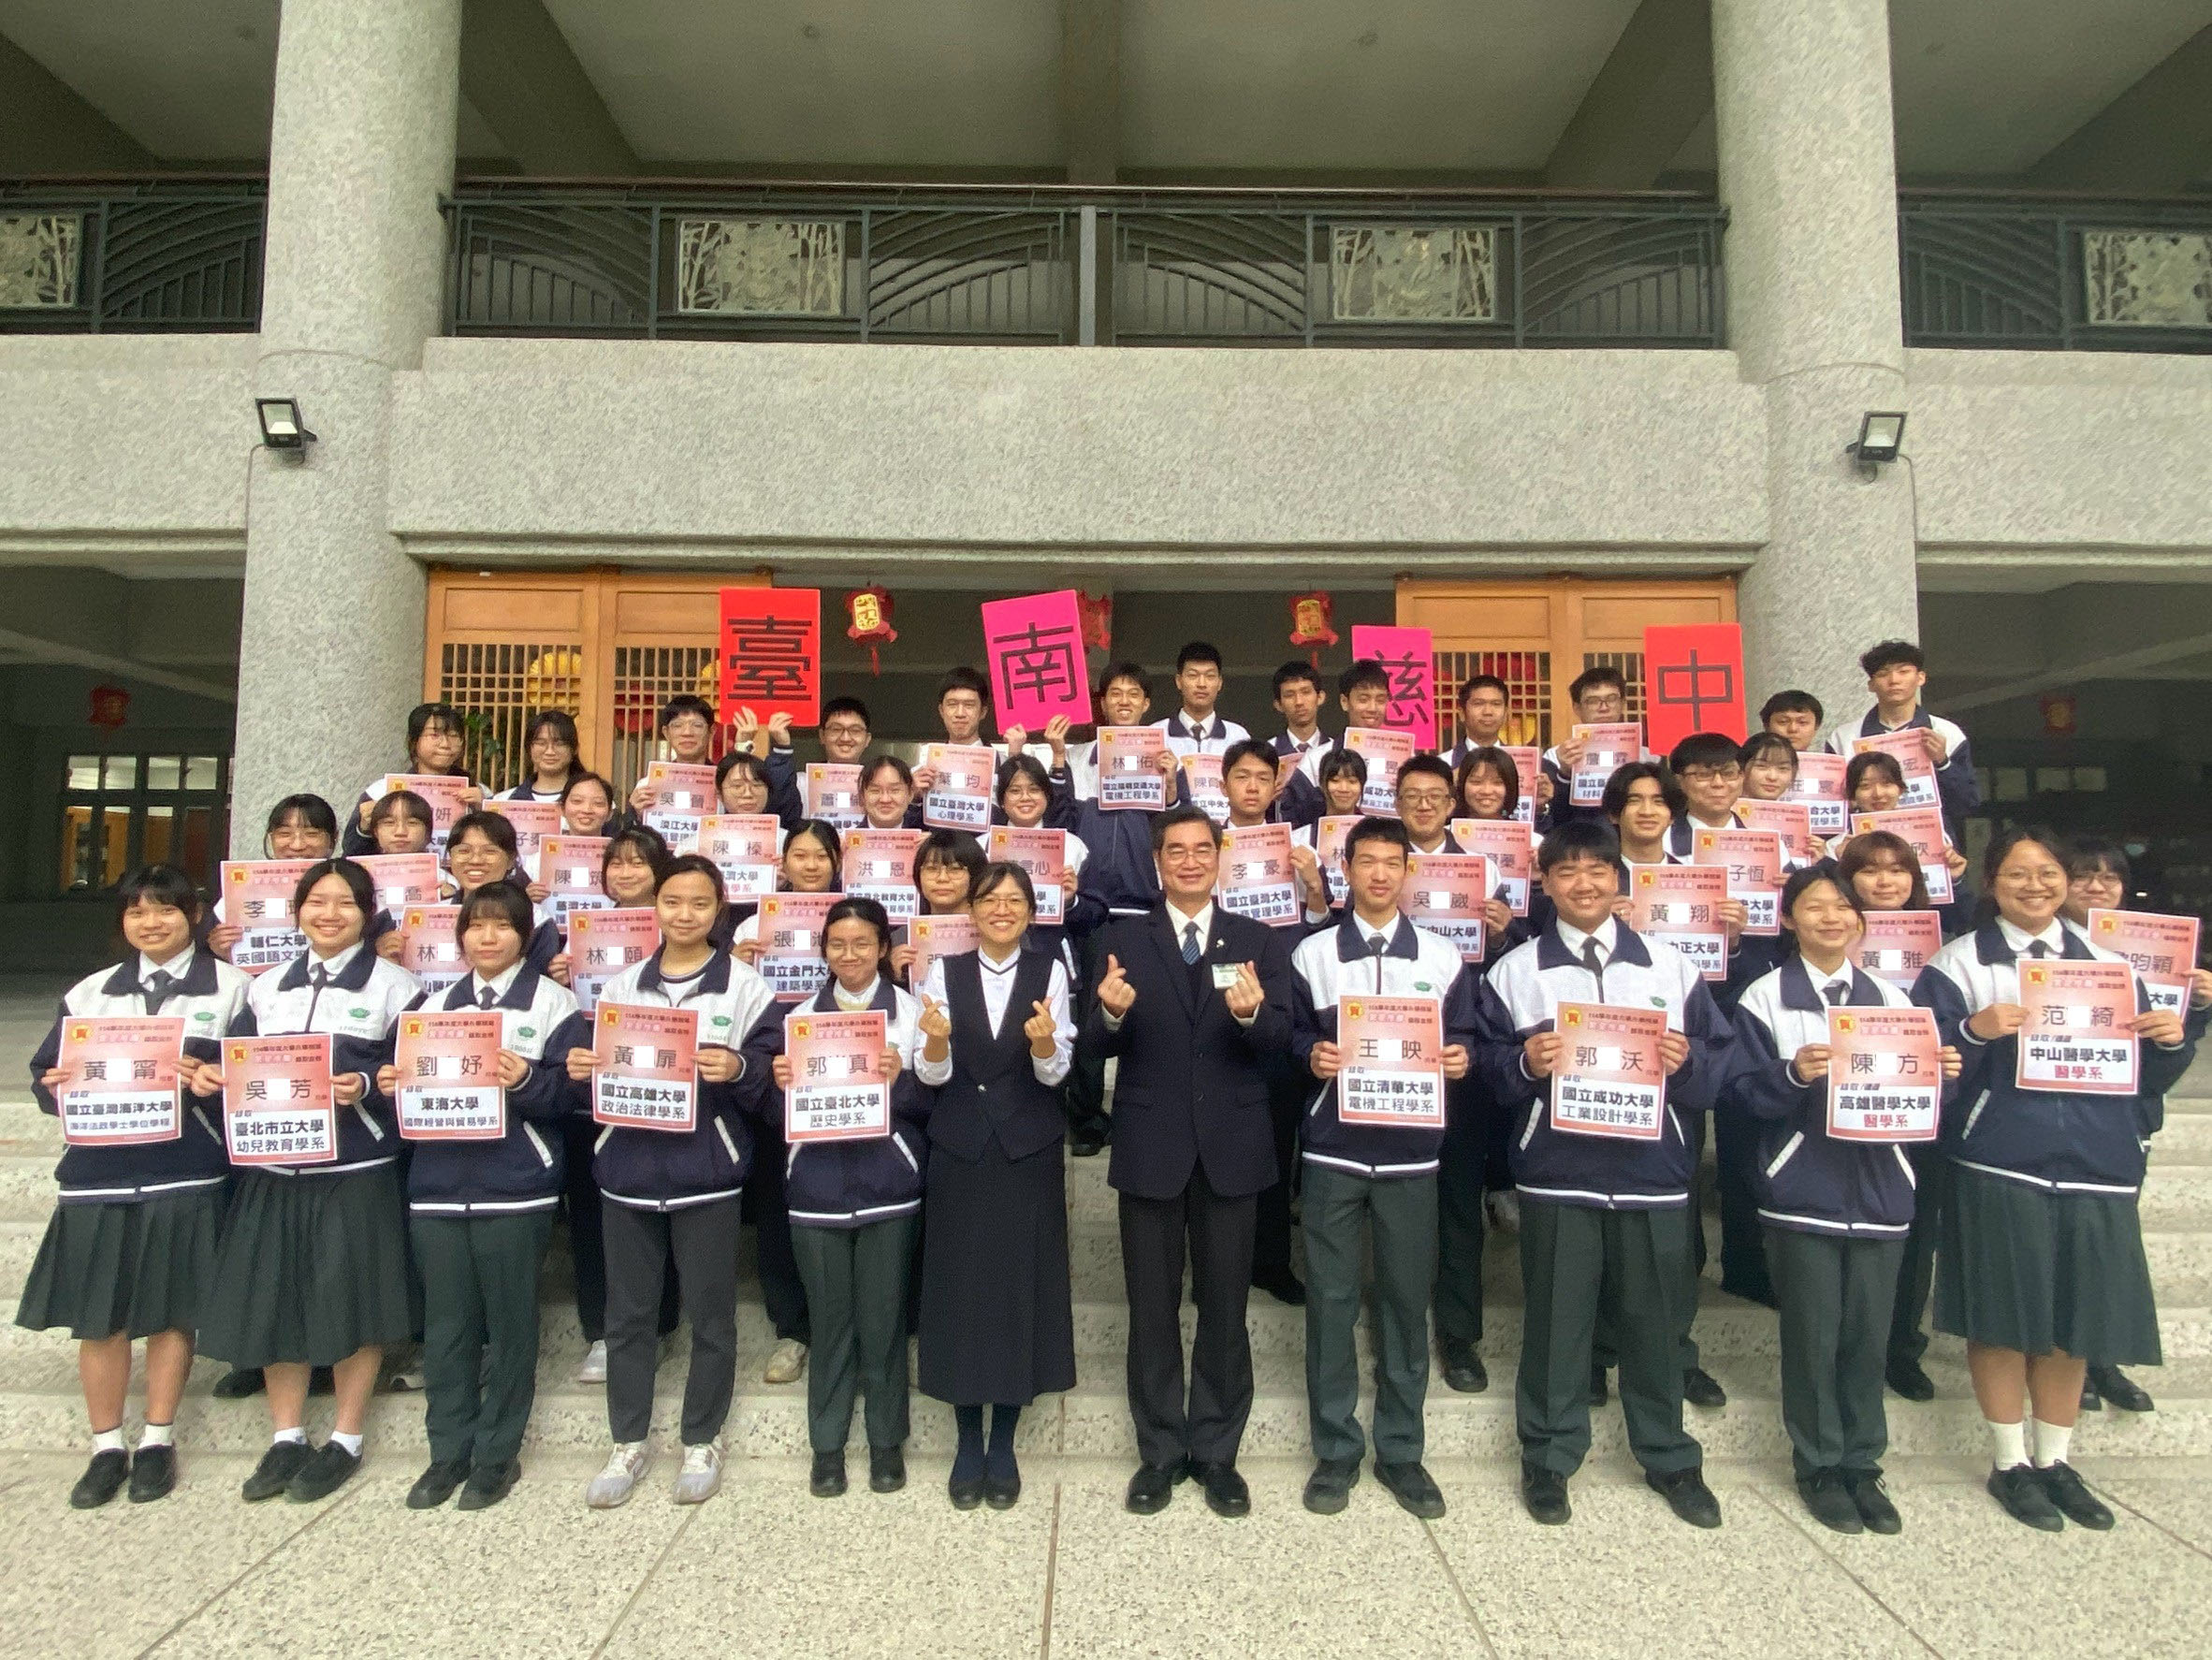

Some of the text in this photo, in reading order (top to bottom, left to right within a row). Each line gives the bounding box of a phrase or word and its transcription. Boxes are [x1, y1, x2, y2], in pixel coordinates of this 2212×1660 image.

[727, 614, 812, 703] 臺
[992, 620, 1077, 711] 南
[1657, 648, 1733, 732] 中
[1113, 756, 1154, 769] 林佑
[929, 797, 985, 811] 國立臺灣大學
[937, 811, 975, 823] 心理學系
[857, 861, 906, 878] 洪恩
[1231, 859, 1281, 881] 李豪
[1226, 890, 1292, 909] 國立臺灣大學
[1413, 892, 1469, 910] 吳崴
[1650, 904, 1710, 924] 黃翔
[250, 934, 308, 949] 輔仁大學
[586, 946, 644, 965] 林頤
[1860, 951, 1924, 969] 黃雅
[763, 965, 831, 977] 國立金門大
[2148, 992, 2178, 1006] 大學
[2041, 1004, 2115, 1027] 范綺
[614, 1045, 677, 1070] 黃扉
[1359, 1038, 1422, 1060] 王映
[1575, 1045, 1644, 1071] 郭沃
[2030, 1047, 2128, 1063] 中山醫學大學
[83, 1058, 157, 1082] 黃甯
[416, 1055, 483, 1077] 劉妤
[807, 1054, 869, 1076] 郭真
[1851, 1053, 1919, 1074] 陳方
[2054, 1065, 2103, 1080] 醫學系
[246, 1079, 312, 1101] 吳芳
[601, 1083, 687, 1103] 國立高雄大學
[1347, 1077, 1434, 1096] 國立清華大學
[420, 1096, 480, 1112] 東海大學
[795, 1093, 880, 1112] 國立臺北大學
[1347, 1095, 1435, 1114] 電機工程學系
[1562, 1085, 1654, 1108] 國立成功大學
[1840, 1096, 1931, 1111] 高雄醫學大學
[65, 1101, 173, 1116] 國立臺灣海洋大學
[601, 1099, 685, 1119] 政治法律學系
[1562, 1104, 1652, 1127] 工業設計學系
[235, 1119, 325, 1137] 臺北市立大學
[809, 1112, 866, 1129] 歷史學系
[1863, 1114, 1909, 1129] 醫學系
[236, 1137, 326, 1153] 幼兒教育學系
